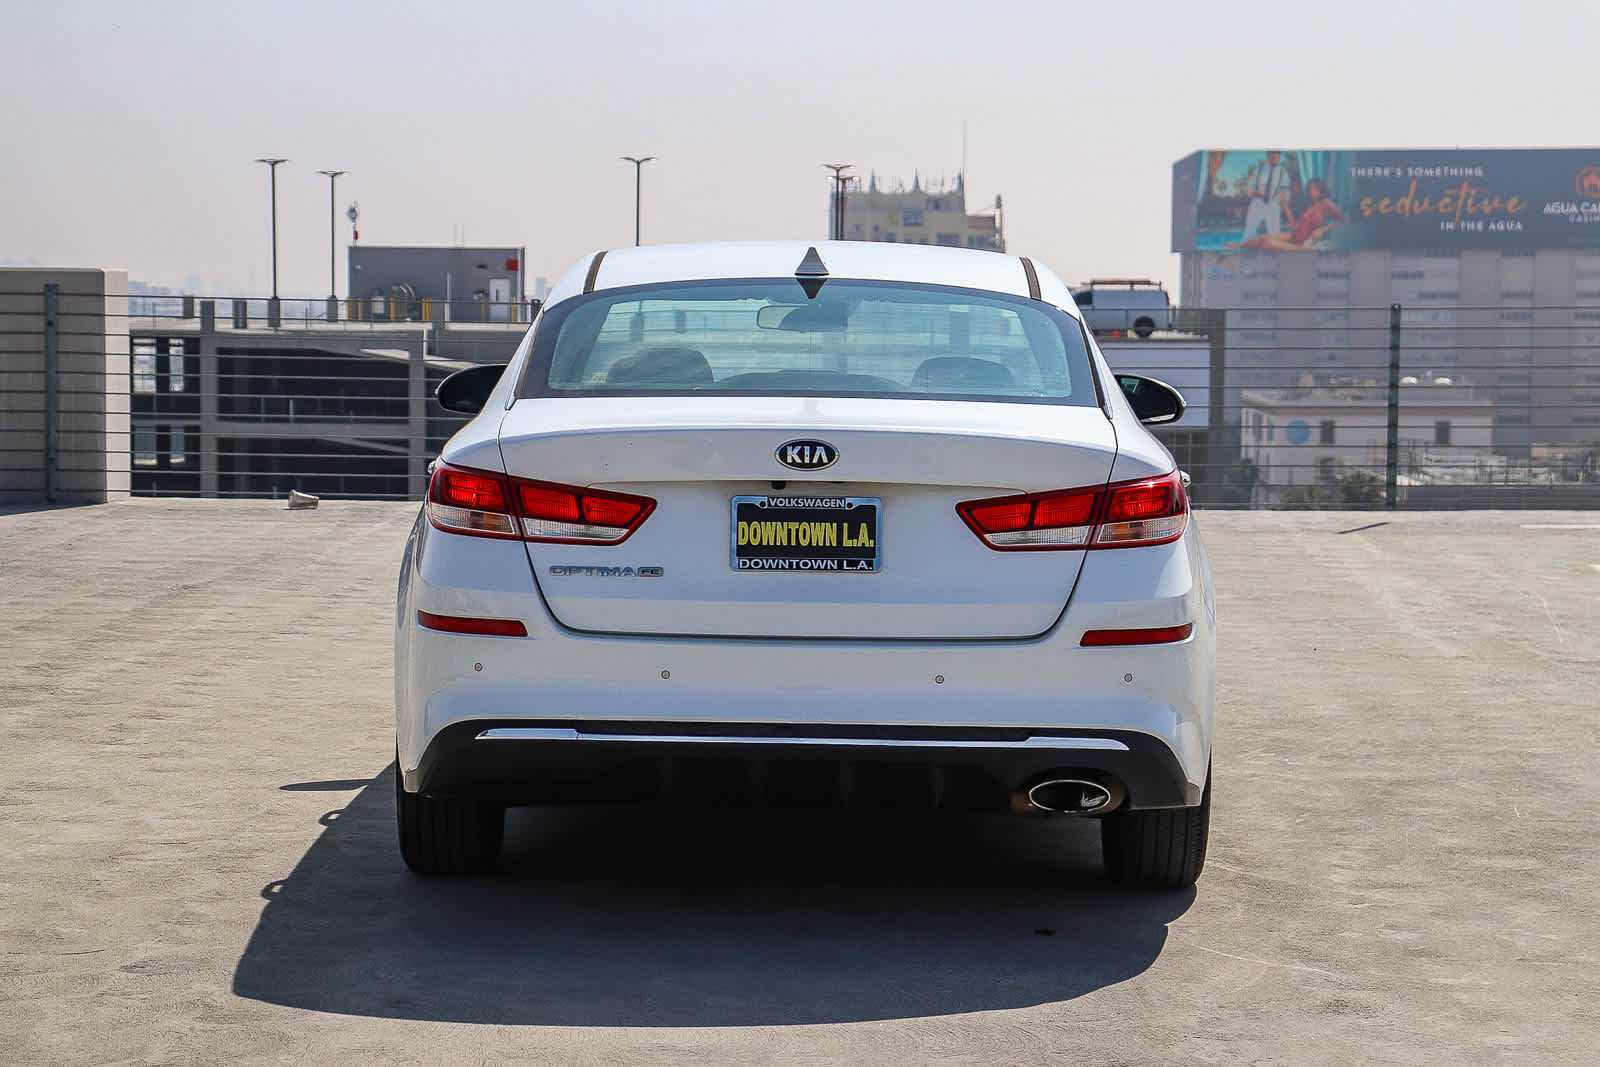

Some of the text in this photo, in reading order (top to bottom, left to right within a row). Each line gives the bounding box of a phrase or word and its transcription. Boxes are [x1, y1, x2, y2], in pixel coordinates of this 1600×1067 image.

[1351, 166, 1484, 177] THERE'S SOMETHING
[1359, 179, 1525, 224] seductive
[1543, 201, 1577, 214] AGUA
[1440, 221, 1523, 232] IN THE AGUA
[786, 446, 828, 464] KIA
[769, 498, 845, 508] VOLKSWAGEN
[738, 521, 874, 547] DOWNTOWN L.A.
[739, 559, 872, 570] DOWNTOWN L.A.
[549, 565, 636, 577] OPTIMA
